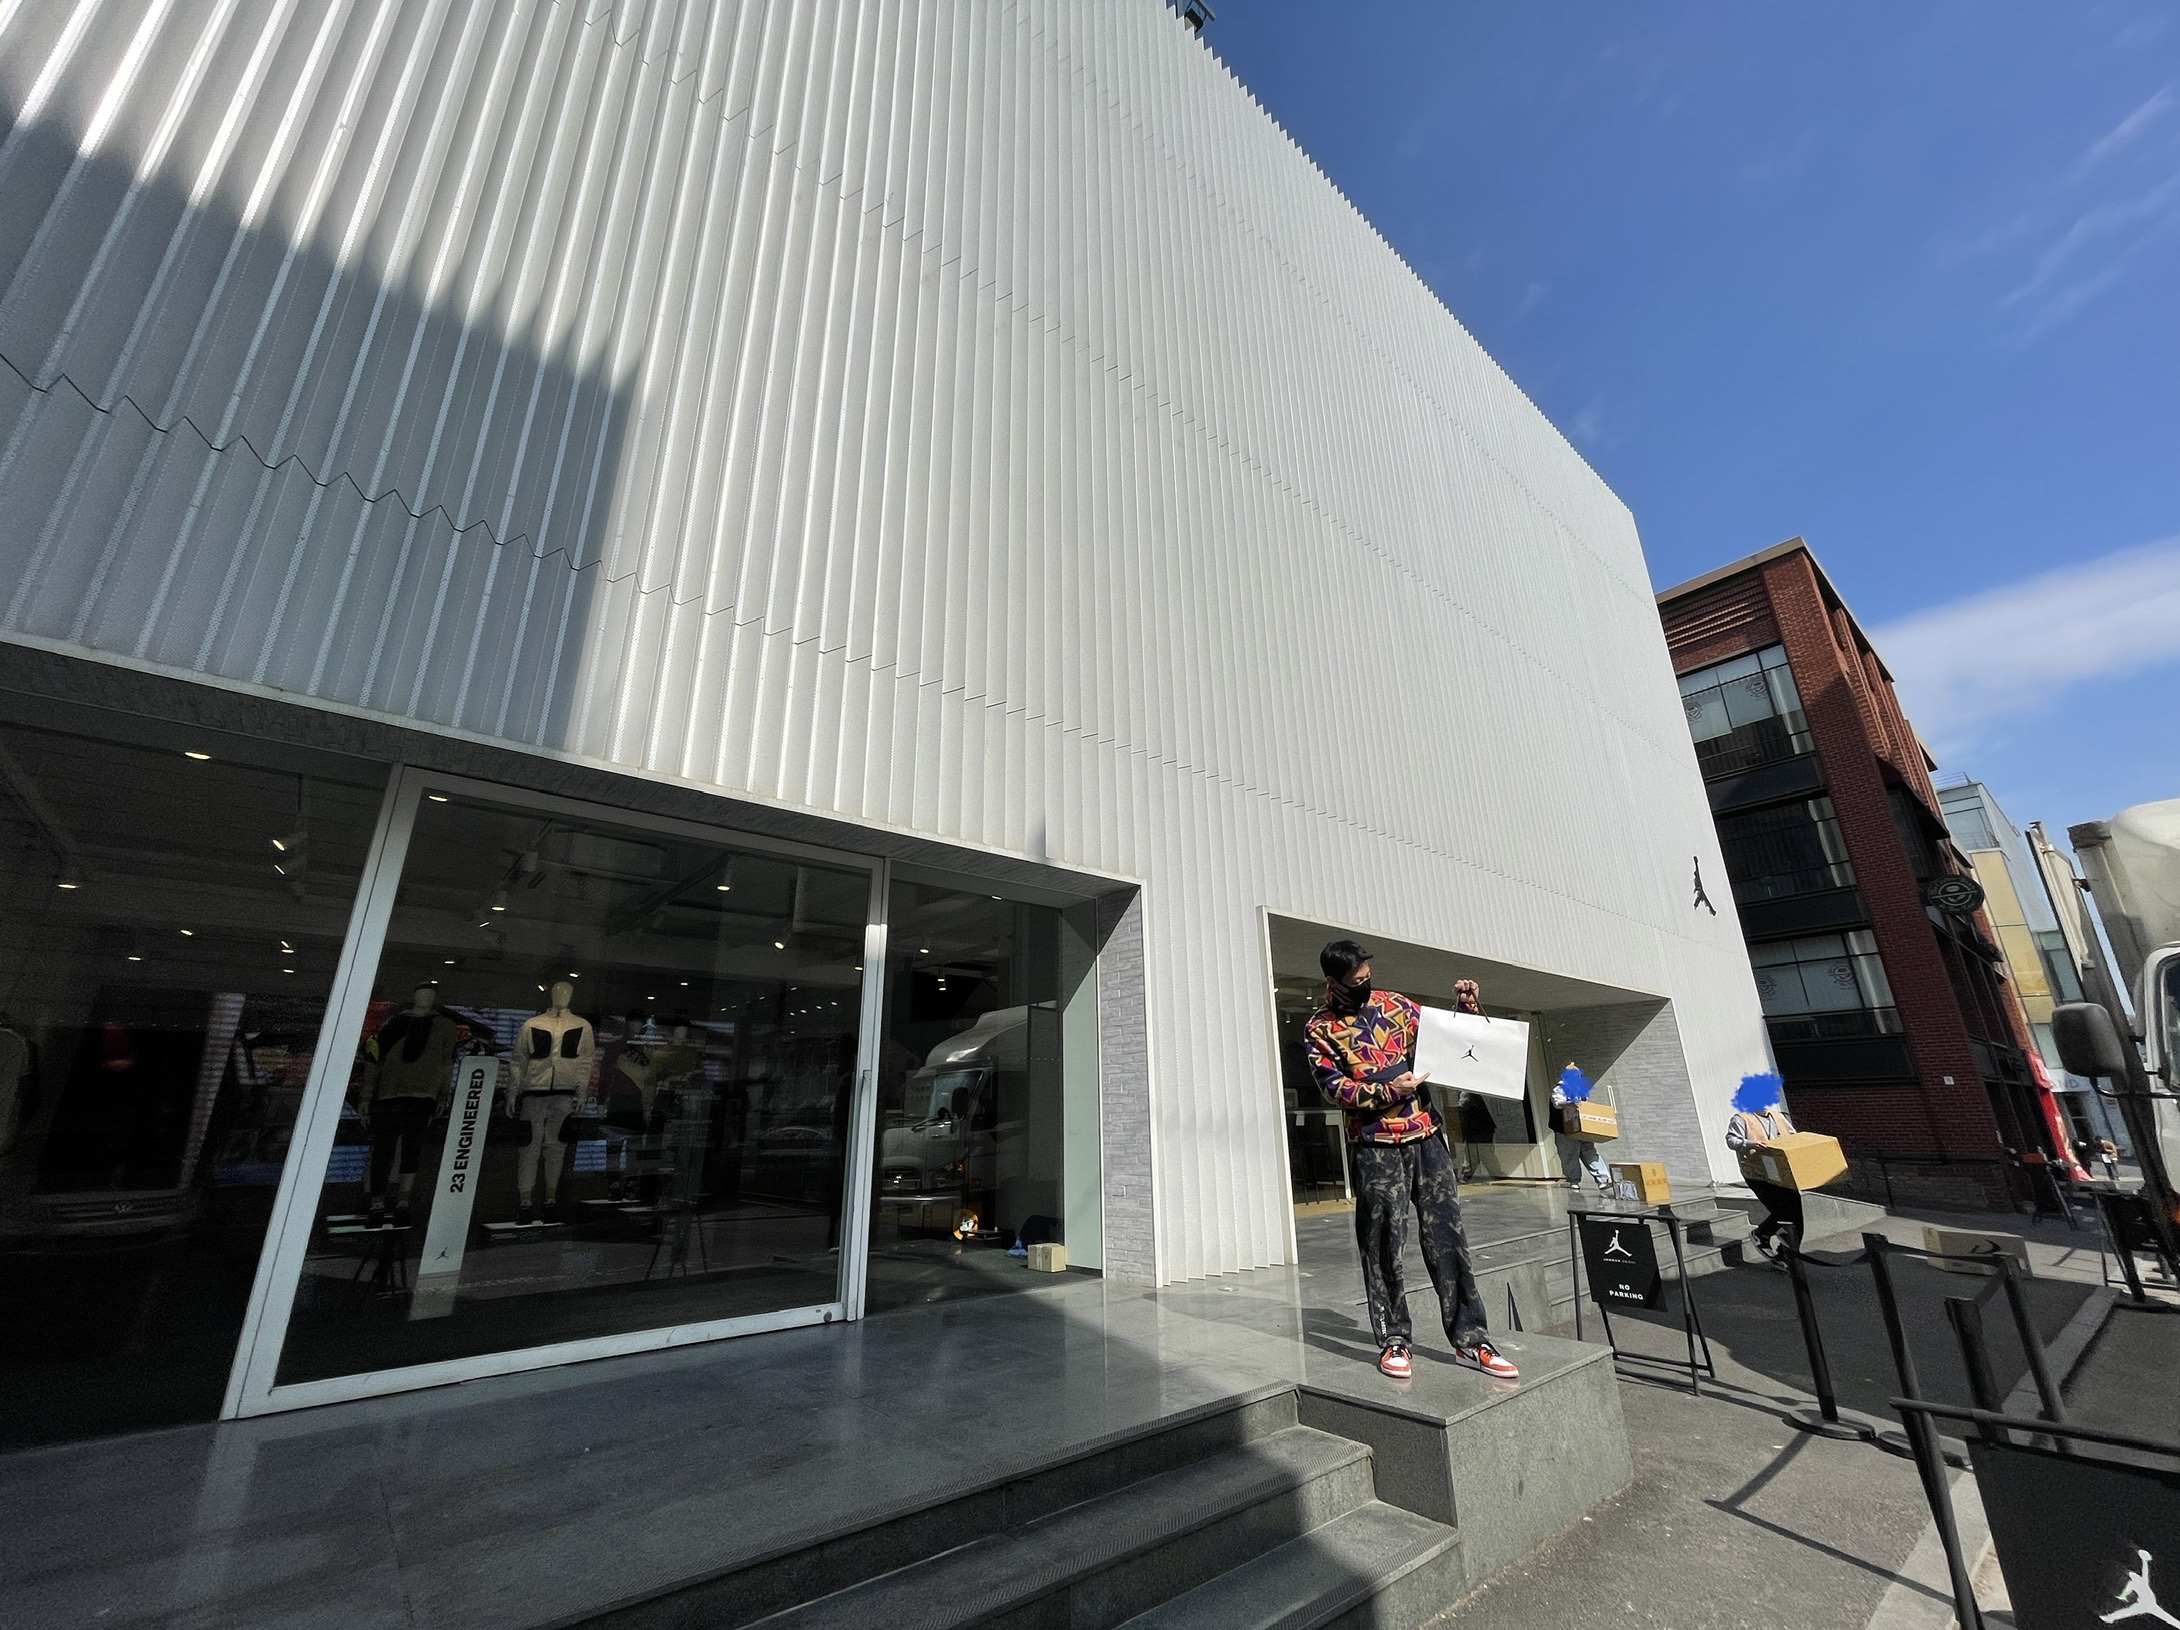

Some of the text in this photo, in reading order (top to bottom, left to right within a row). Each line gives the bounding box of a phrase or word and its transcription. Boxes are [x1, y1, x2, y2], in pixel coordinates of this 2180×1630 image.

[450, 1068, 485, 1193] 23 ENGINEERED
[1618, 1283, 1630, 1291] NO
[1609, 1290, 1644, 1300] PARKING
